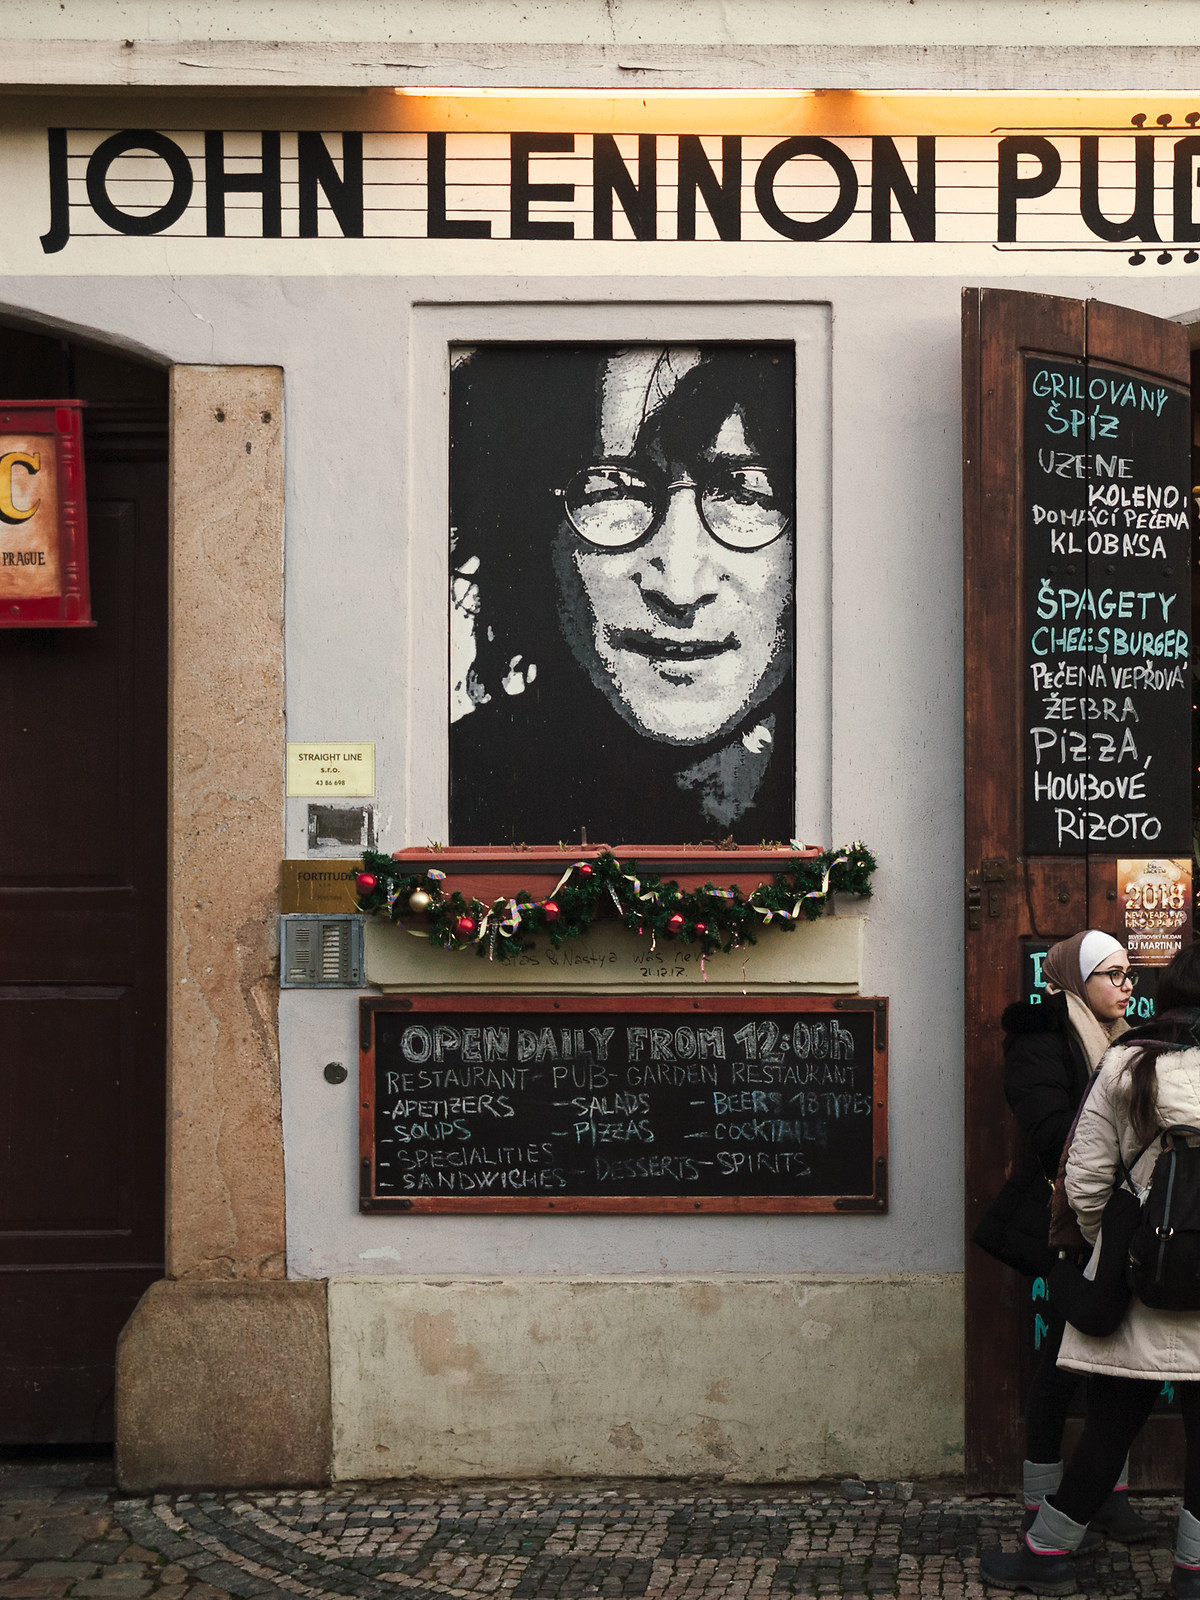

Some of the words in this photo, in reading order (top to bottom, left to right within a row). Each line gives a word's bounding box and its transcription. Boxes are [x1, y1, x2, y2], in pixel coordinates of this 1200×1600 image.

[40, 128, 363, 254] JOHN
[427, 132, 934, 242] LENNON
[3, 551, 46, 566] PRAGUE
[1037, 579, 1177, 623] ŠPAGETY
[298, 753, 341, 761] STRAIGHT
[343, 753, 363, 761] LINE
[1125, 883, 1185, 911] 2018
[1128, 942, 1139, 950] DJ
[1140, 942, 1172, 950] MARTIN
[1174, 942, 1182, 950] N
[401, 1025, 510, 1063] OPEN
[518, 1027, 614, 1062] DAILY
[627, 1027, 726, 1062] FROM
[627, 1064, 718, 1086] GARDEN
[732, 1062, 857, 1087] RESTAURANT
